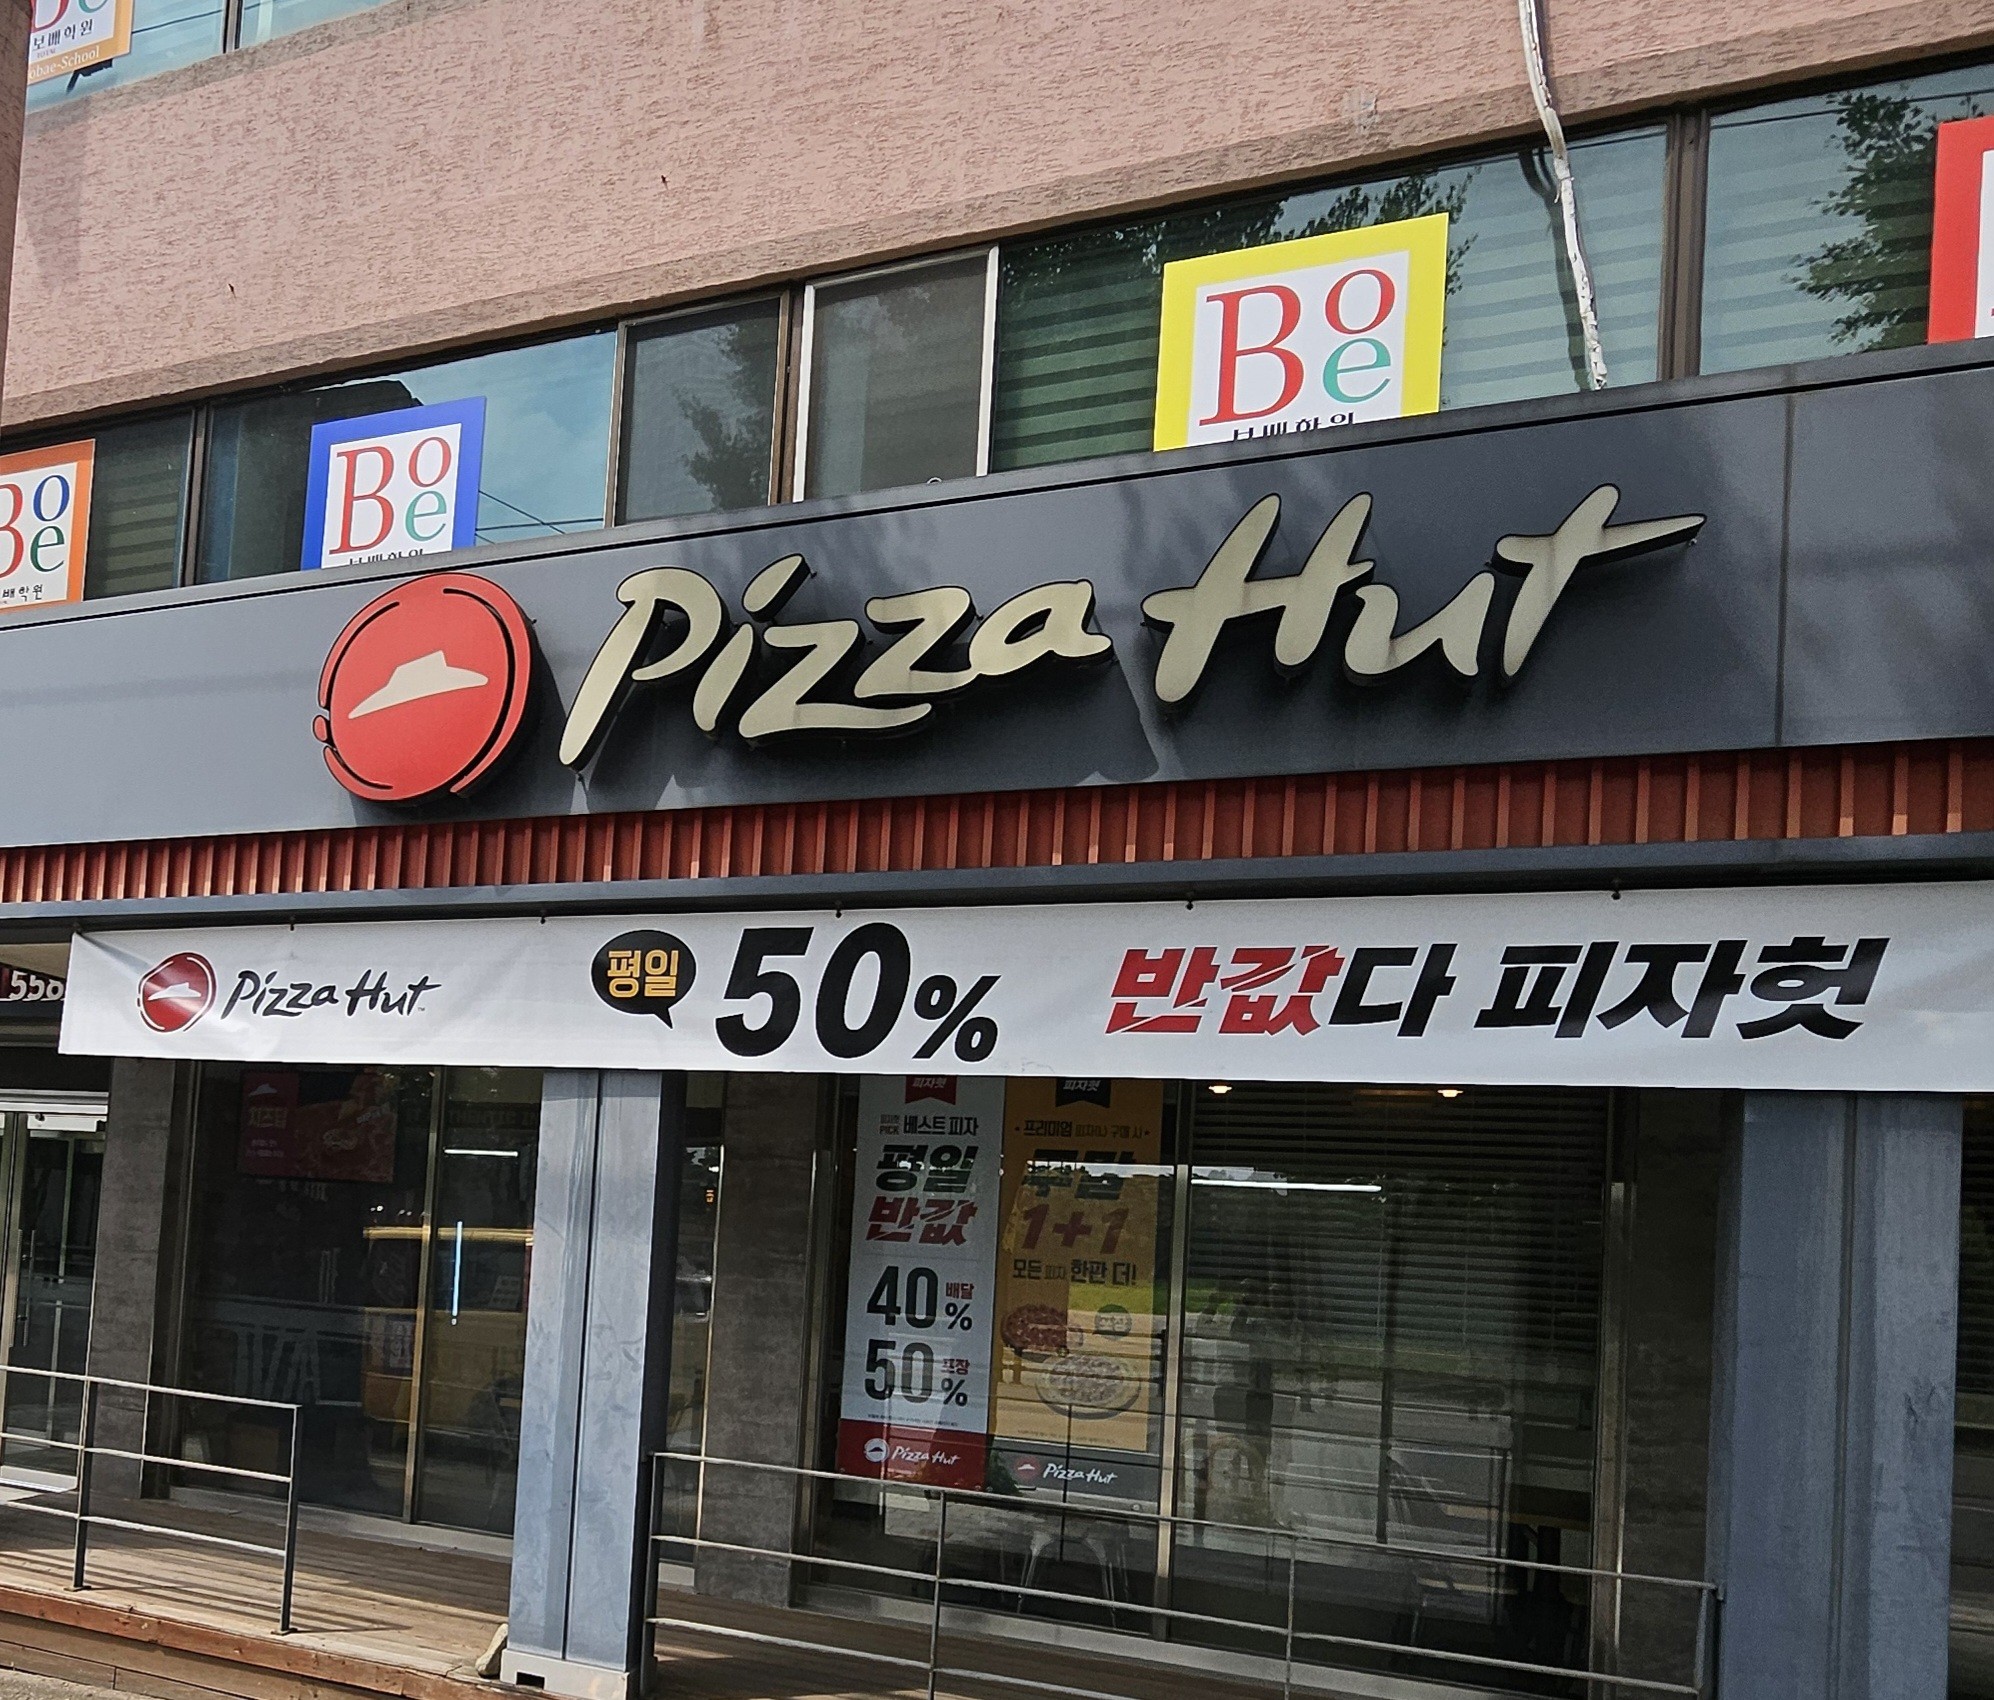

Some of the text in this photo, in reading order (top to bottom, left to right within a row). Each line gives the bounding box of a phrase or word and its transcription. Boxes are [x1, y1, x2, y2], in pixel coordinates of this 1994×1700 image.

[559, 483, 1706, 768] Pizza Hut
[221, 968, 441, 1020] Pizza Hut
[607, 949, 679, 998] 평일
[715, 922, 1001, 1063] 50%
[1105, 936, 1891, 1040] 반값다 피자헛
[903, 1115, 979, 1136] 베스트 피자
[875, 1144, 979, 1193] 평일
[866, 1196, 979, 1247] 반값
[1022, 1203, 1129, 1254] 1+1
[945, 1282, 974, 1300] 배달
[1012, 1259, 1042, 1280] 모든
[1071, 1259, 1108, 1284] 한판
[1112, 1261, 1138, 1286] 더!
[891, 1446, 961, 1466] Pizza Hut
[1043, 1462, 1118, 1487] Pizza Hut
